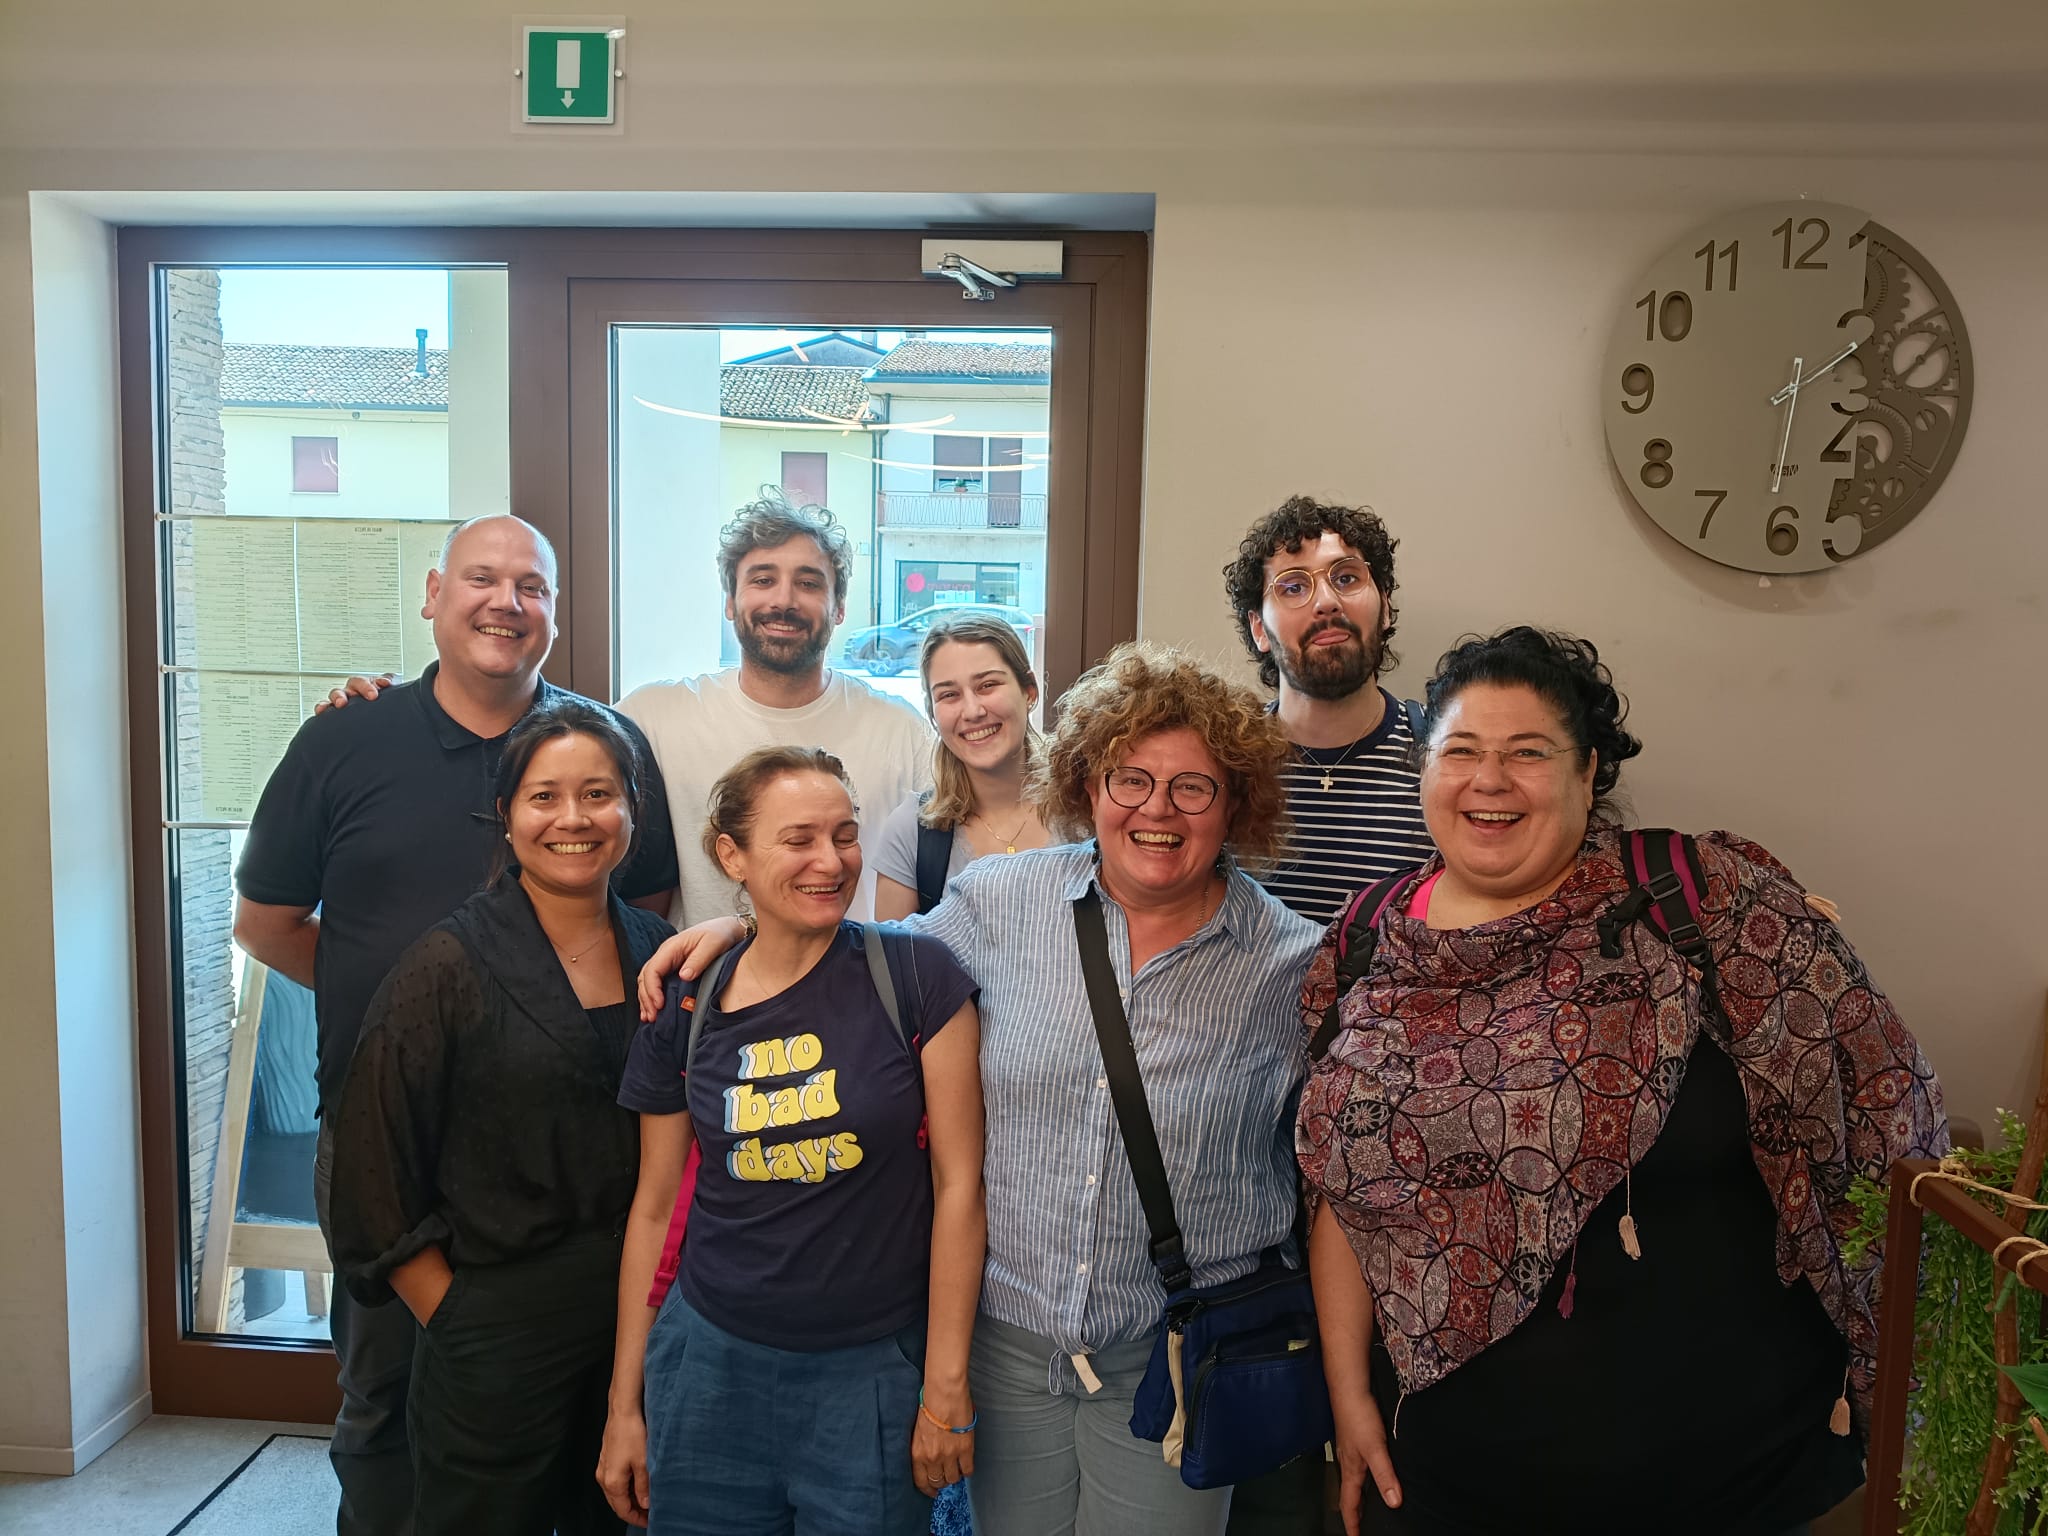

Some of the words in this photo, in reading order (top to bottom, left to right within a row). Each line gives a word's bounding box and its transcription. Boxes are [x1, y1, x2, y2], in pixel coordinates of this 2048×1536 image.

[1694, 239, 1740, 291] 11
[1772, 217, 1831, 270] 12
[1636, 290, 1693, 342] 10
[1621, 363, 1655, 414] 9
[1640, 438, 1673, 489] 8
[1820, 416, 1858, 463] 4
[1694, 490, 1728, 539] 7
[1766, 505, 1799, 556] 6
[1822, 478, 1862, 563] 5
[737, 1033, 823, 1080] no
[722, 1068, 841, 1134] bad
[726, 1131, 864, 1184] days
